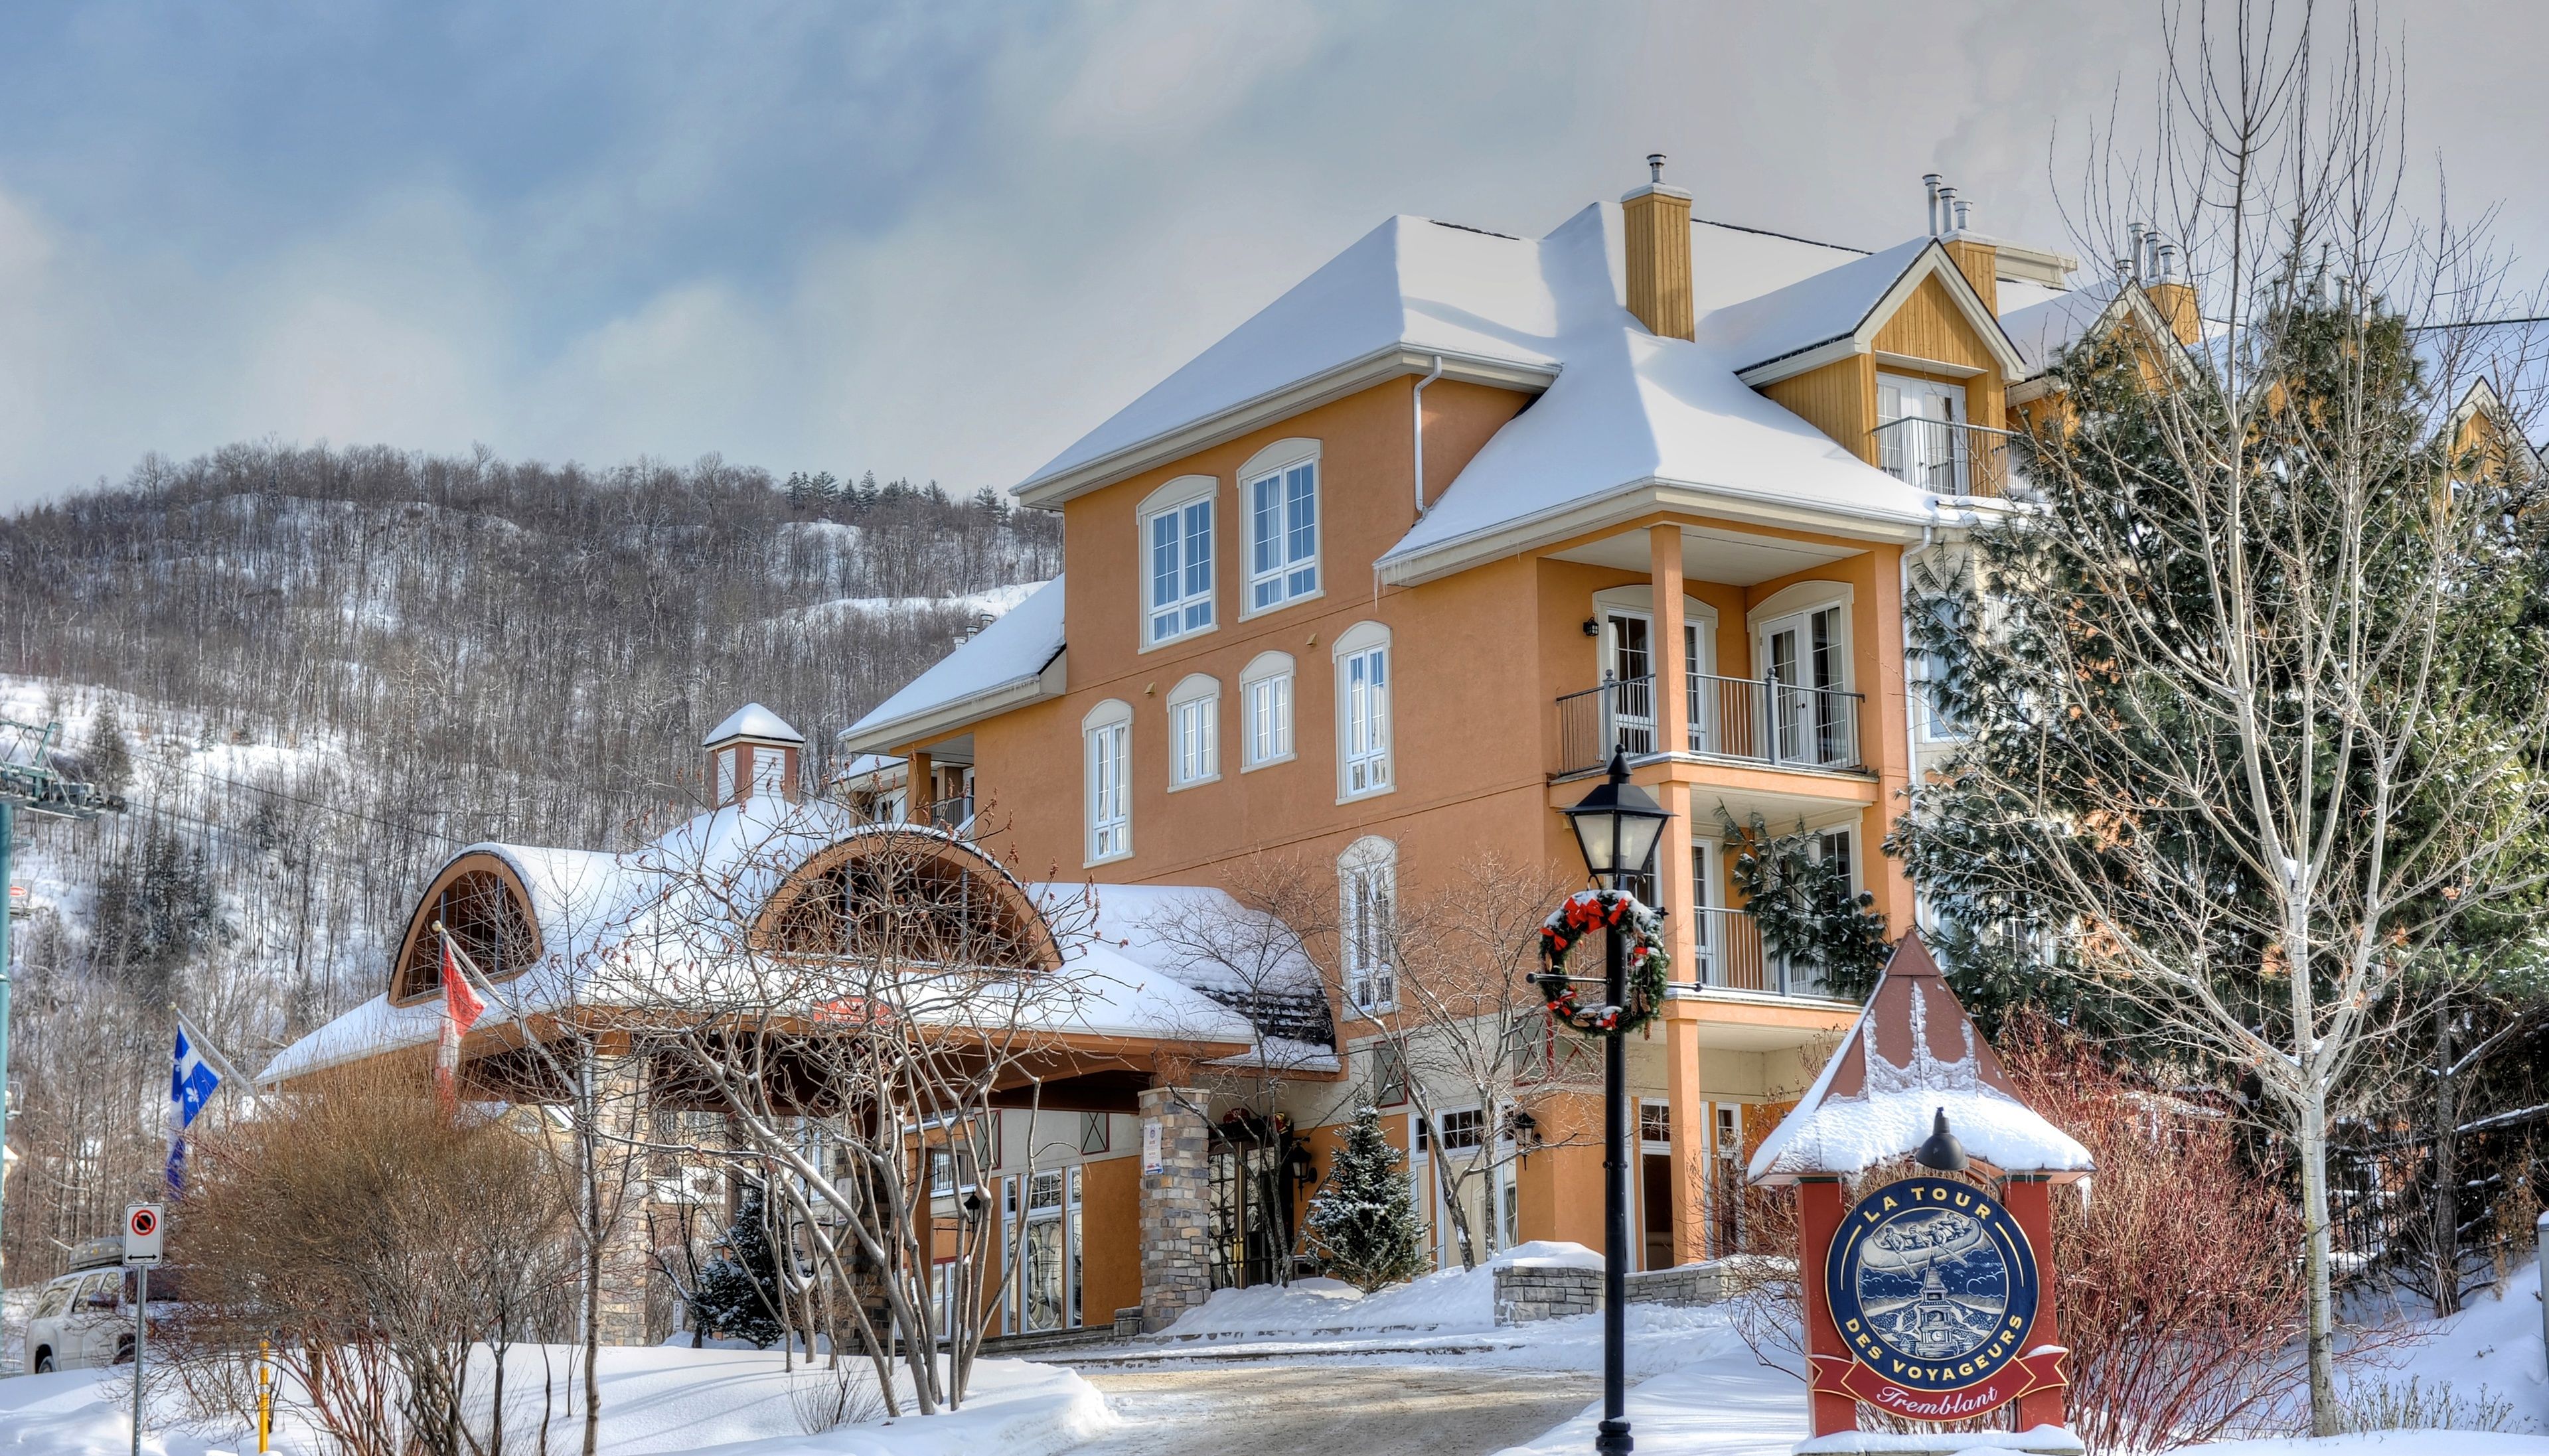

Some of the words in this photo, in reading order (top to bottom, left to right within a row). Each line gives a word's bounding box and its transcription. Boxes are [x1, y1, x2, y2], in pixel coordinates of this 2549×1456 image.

[1863, 1197, 1898, 1223] LA
[1911, 1187, 1991, 1220] TOUR
[1845, 1317, 1883, 1360] DES
[1892, 1314, 2023, 1381] VOYAGEURS
[1877, 1385, 1998, 1415] Tremblant
